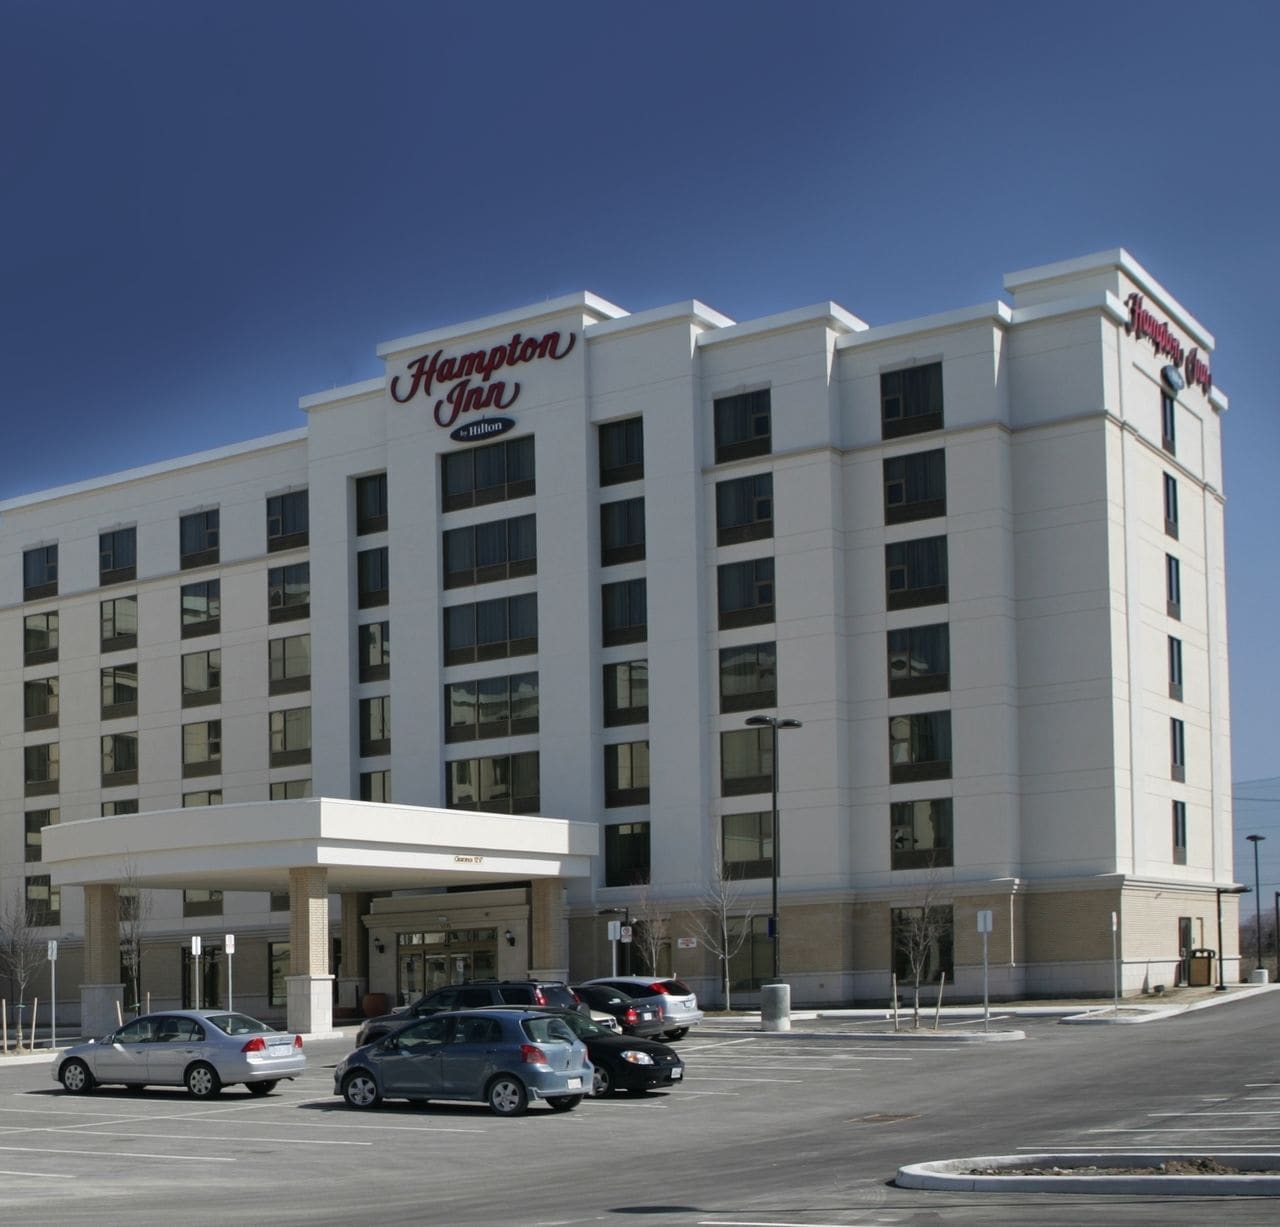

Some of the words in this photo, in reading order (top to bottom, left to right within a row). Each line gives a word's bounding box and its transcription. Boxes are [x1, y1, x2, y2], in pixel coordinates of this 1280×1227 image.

[390, 331, 576, 403] Hampton
[433, 379, 520, 428] Inn
[469, 421, 502, 437] Hilton
